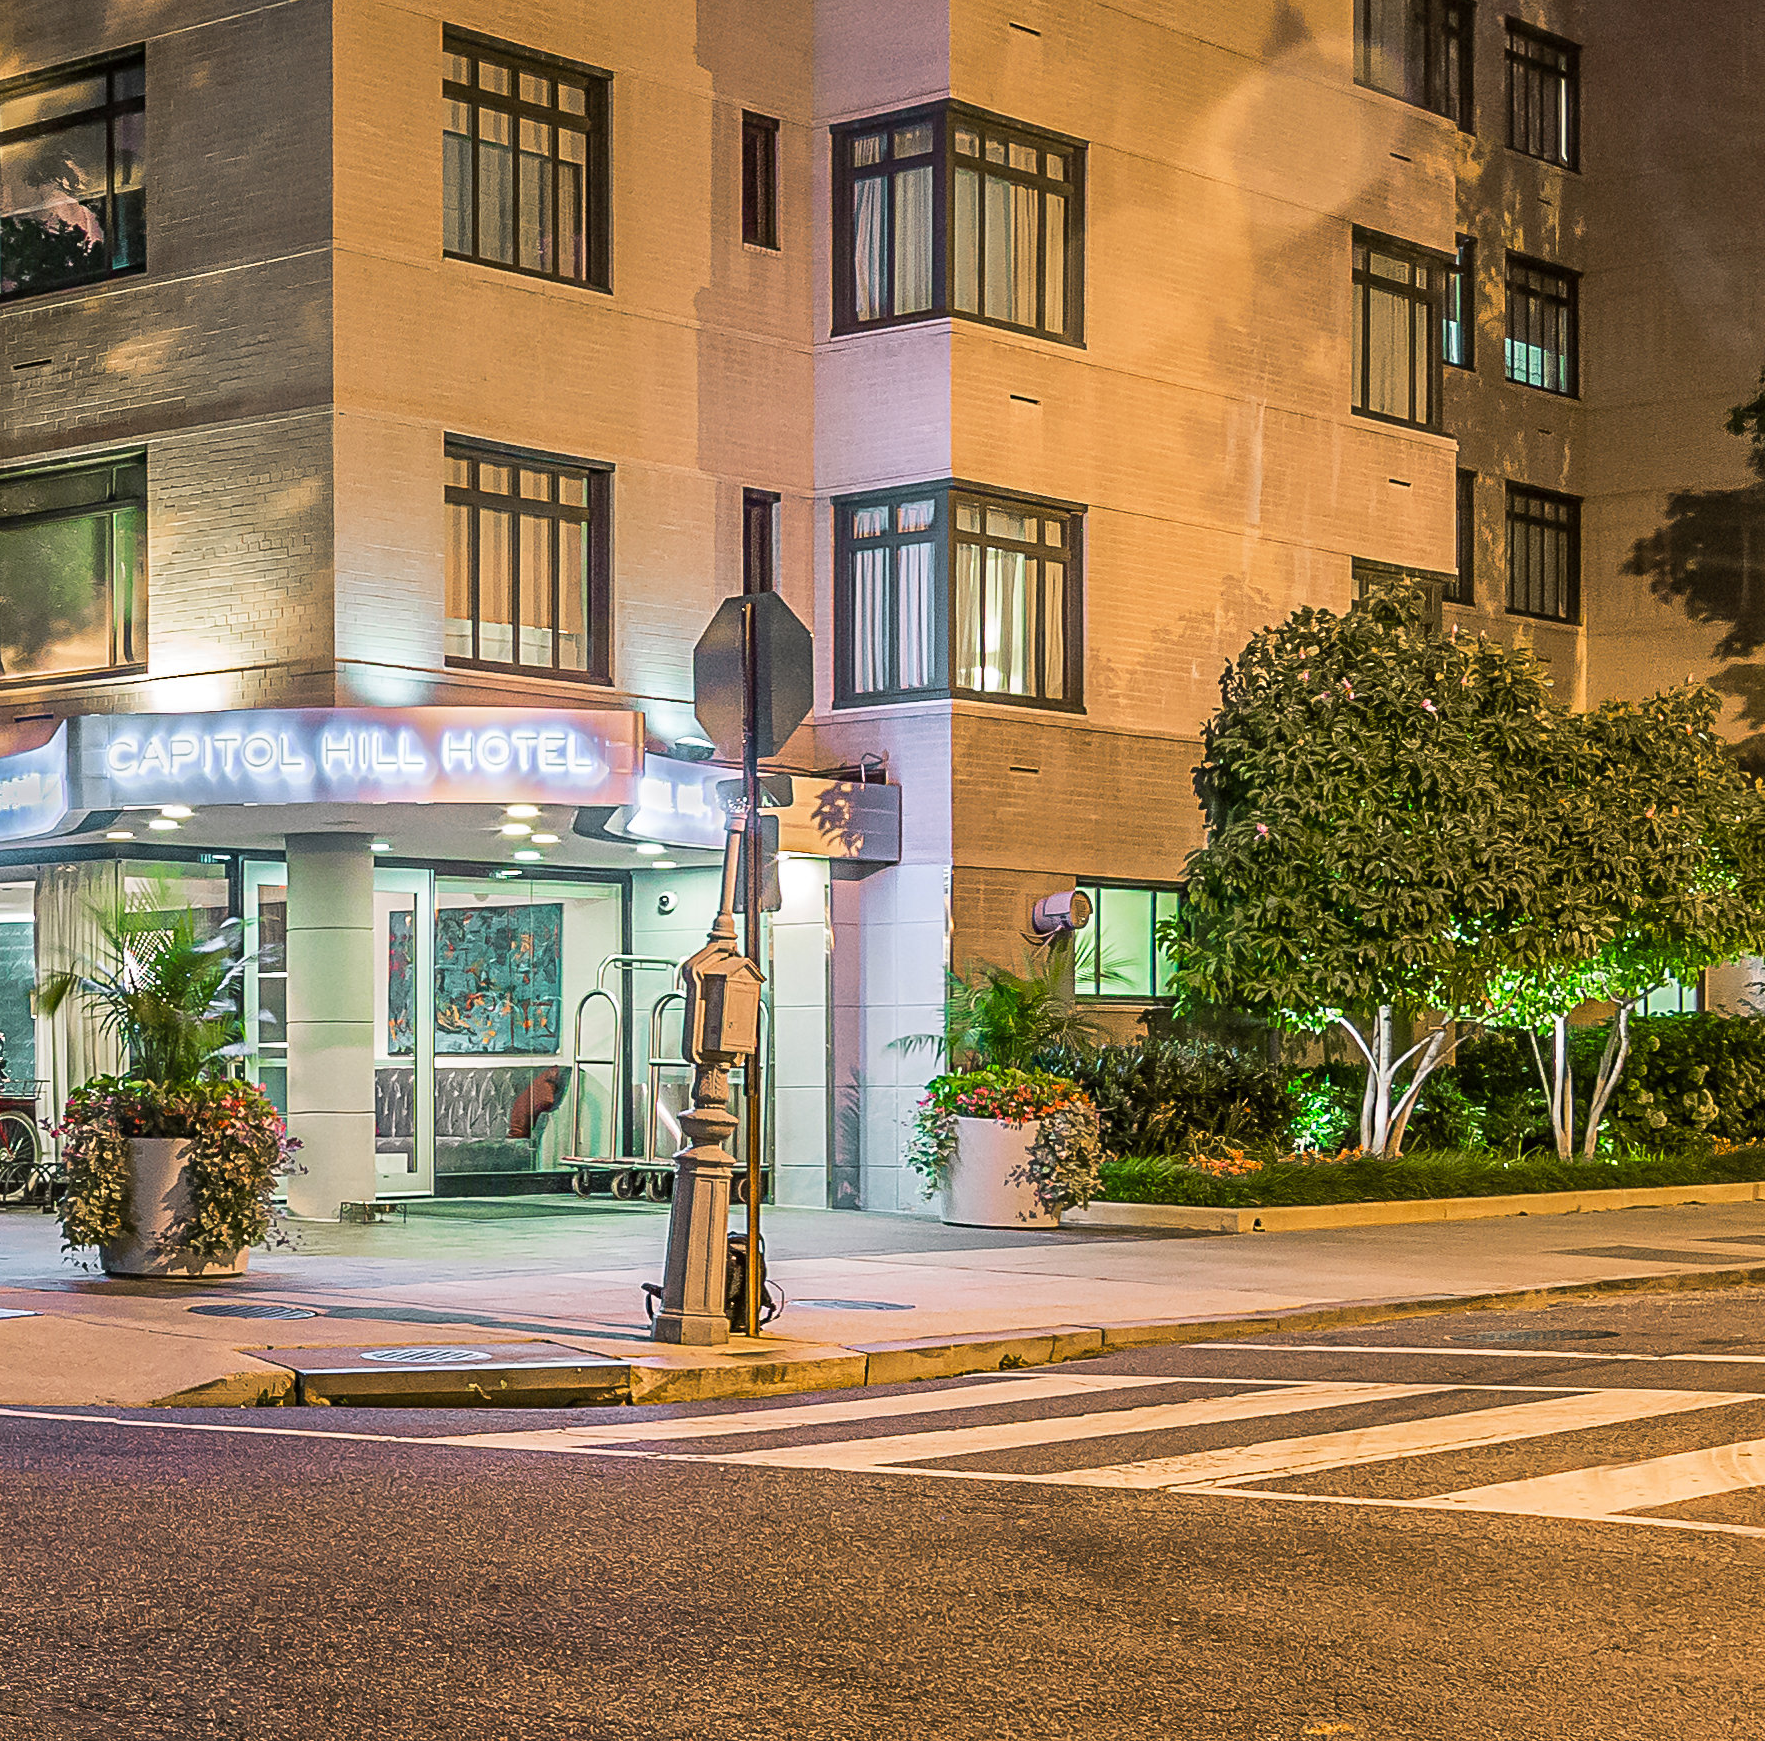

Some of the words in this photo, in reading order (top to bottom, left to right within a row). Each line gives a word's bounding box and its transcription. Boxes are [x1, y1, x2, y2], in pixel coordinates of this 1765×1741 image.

[106, 731, 306, 772] CAPITOL
[321, 729, 425, 771] HILL
[441, 732, 598, 773] HOTEL
